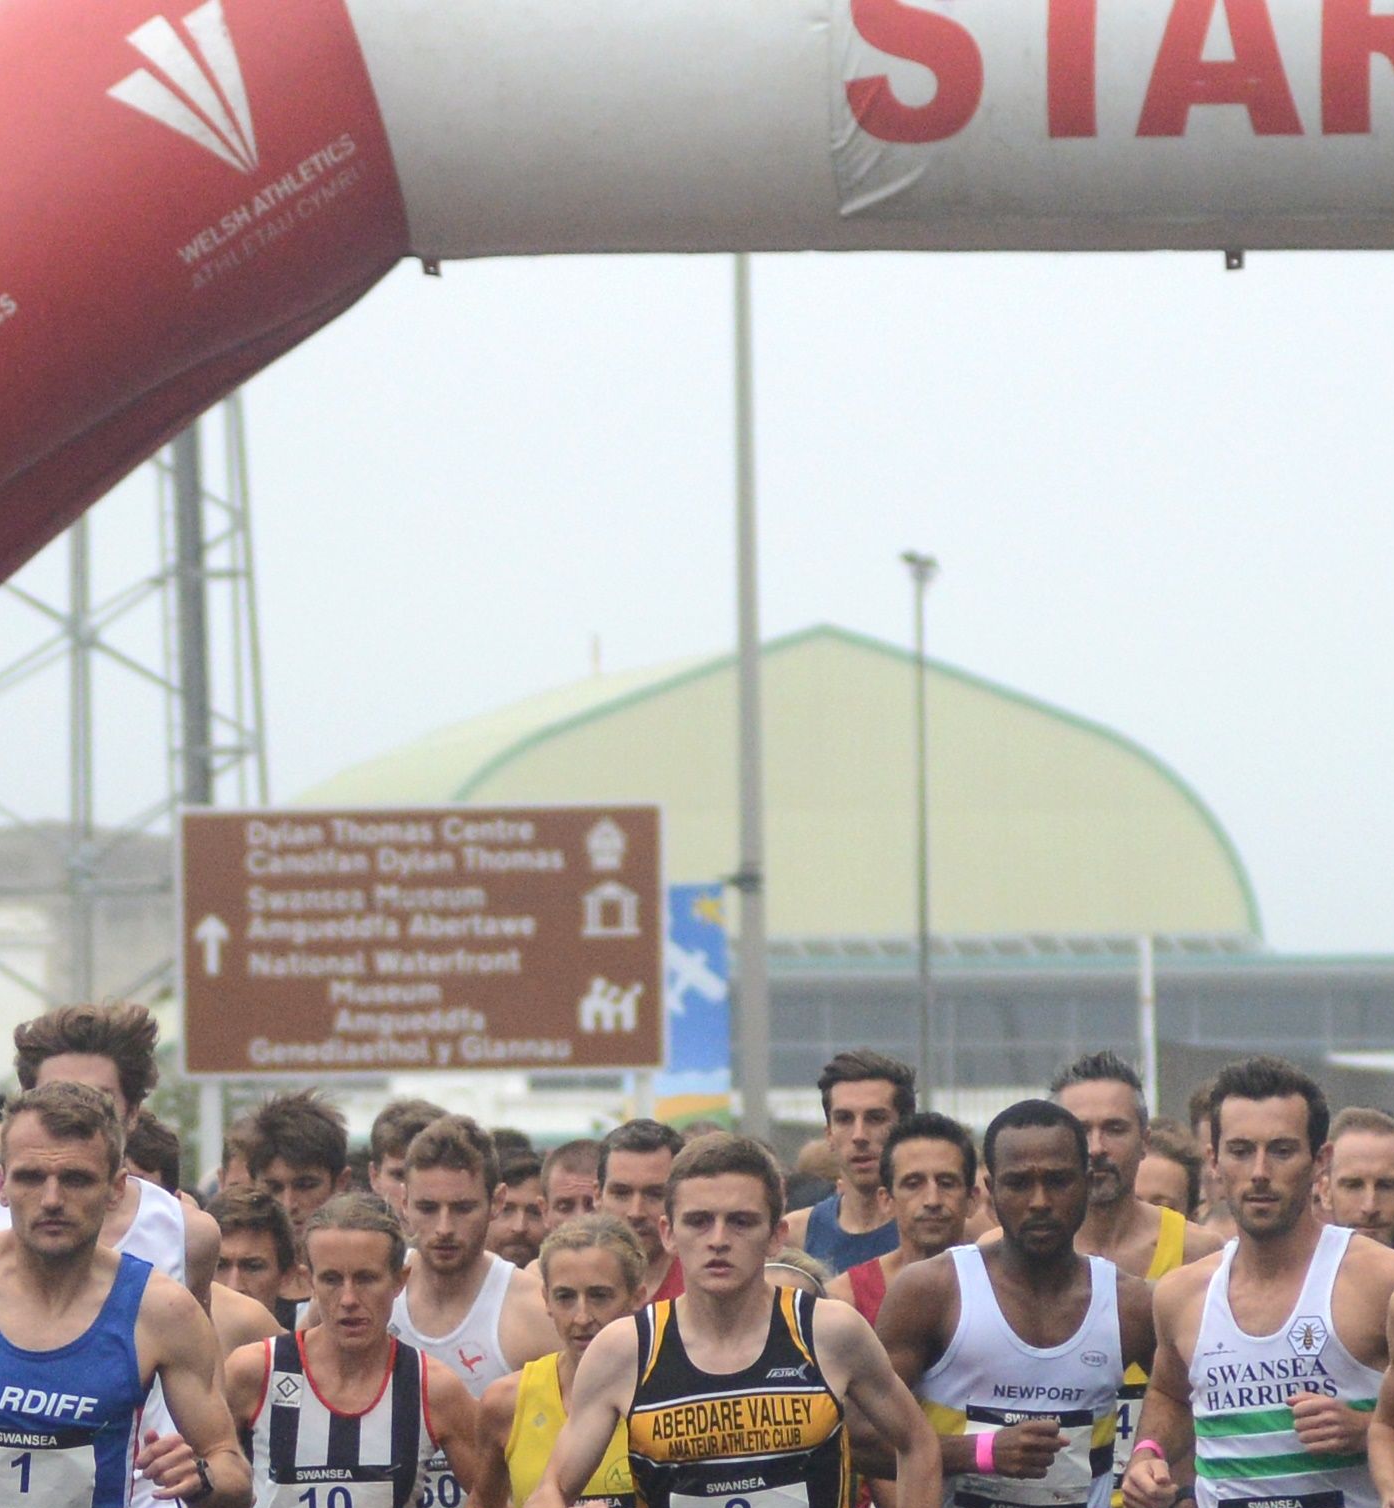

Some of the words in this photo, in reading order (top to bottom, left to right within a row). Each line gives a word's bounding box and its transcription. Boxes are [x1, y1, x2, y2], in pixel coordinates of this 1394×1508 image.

[176, 204, 252, 265] WELSH
[253, 132, 356, 218] ATHLETICS
[247, 819, 324, 848] Dylan
[331, 819, 434, 843] Thomas
[442, 817, 535, 842] Centre
[377, 848, 455, 876] Dylan
[463, 846, 565, 871] Thomas
[374, 884, 487, 910] Museum
[248, 951, 365, 976] National
[374, 949, 521, 974] Waterfront
[329, 980, 442, 1005] Museum
[1207, 1356, 1330, 1388] SWANSEA
[993, 1384, 1085, 1401] NEWPORT
[652, 1400, 745, 1442] ABERDARE
[747, 1397, 813, 1428] VALLEY
[668, 1436, 718, 1459] AMATEUR
[720, 1430, 771, 1454] ATHLETIC
[772, 1427, 802, 1449] CLUB
[10, 1451, 32, 1494] 1
[296, 1468, 353, 1481] SWANSEA
[706, 1476, 767, 1494] SWANSEA
